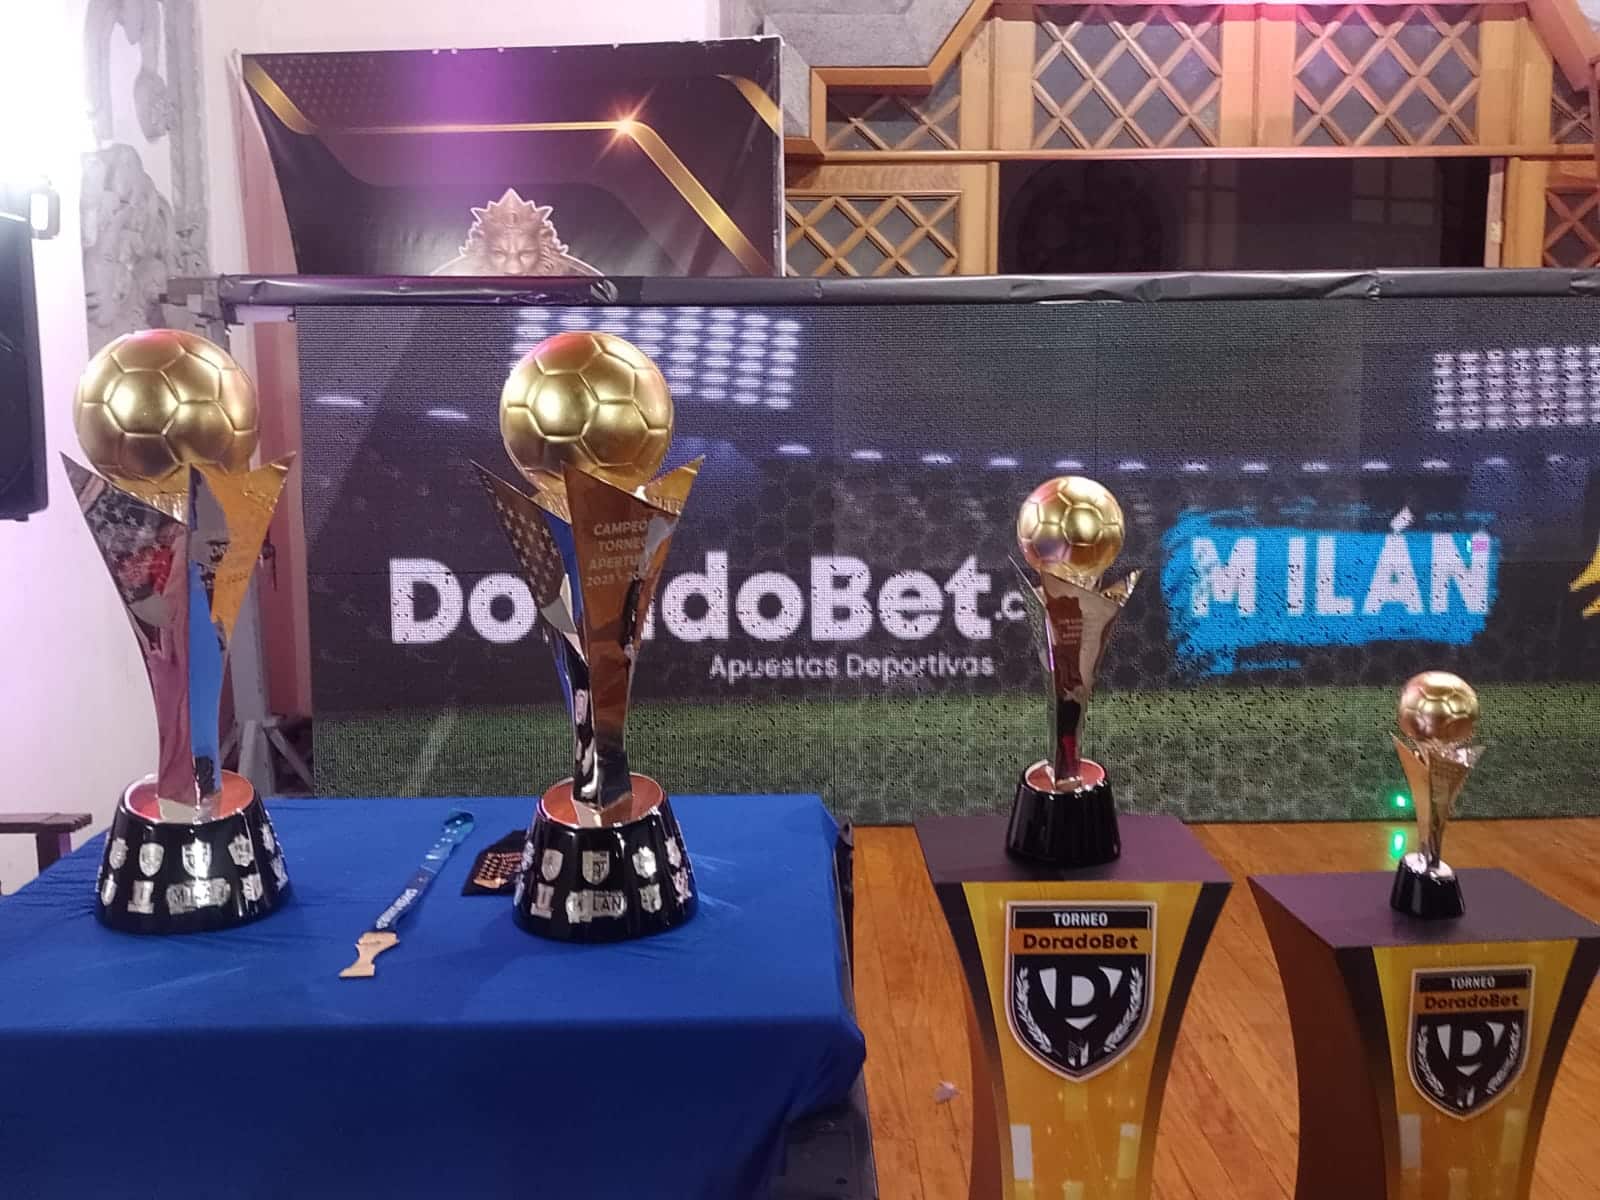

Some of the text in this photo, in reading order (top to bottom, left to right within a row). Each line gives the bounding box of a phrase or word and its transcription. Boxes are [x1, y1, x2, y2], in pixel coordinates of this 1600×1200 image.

[593, 519, 648, 536] CAMPEO
[589, 554, 642, 570] APERTU
[389, 550, 1027, 644] DodoBet.c
[709, 652, 995, 685] Apuestas Deportivas
[1053, 911, 1109, 927] TORNEO
[1023, 933, 1139, 950] DoradoBet
[1450, 975, 1496, 990] TORNEO
[1424, 993, 1520, 1010] DoradoBet
